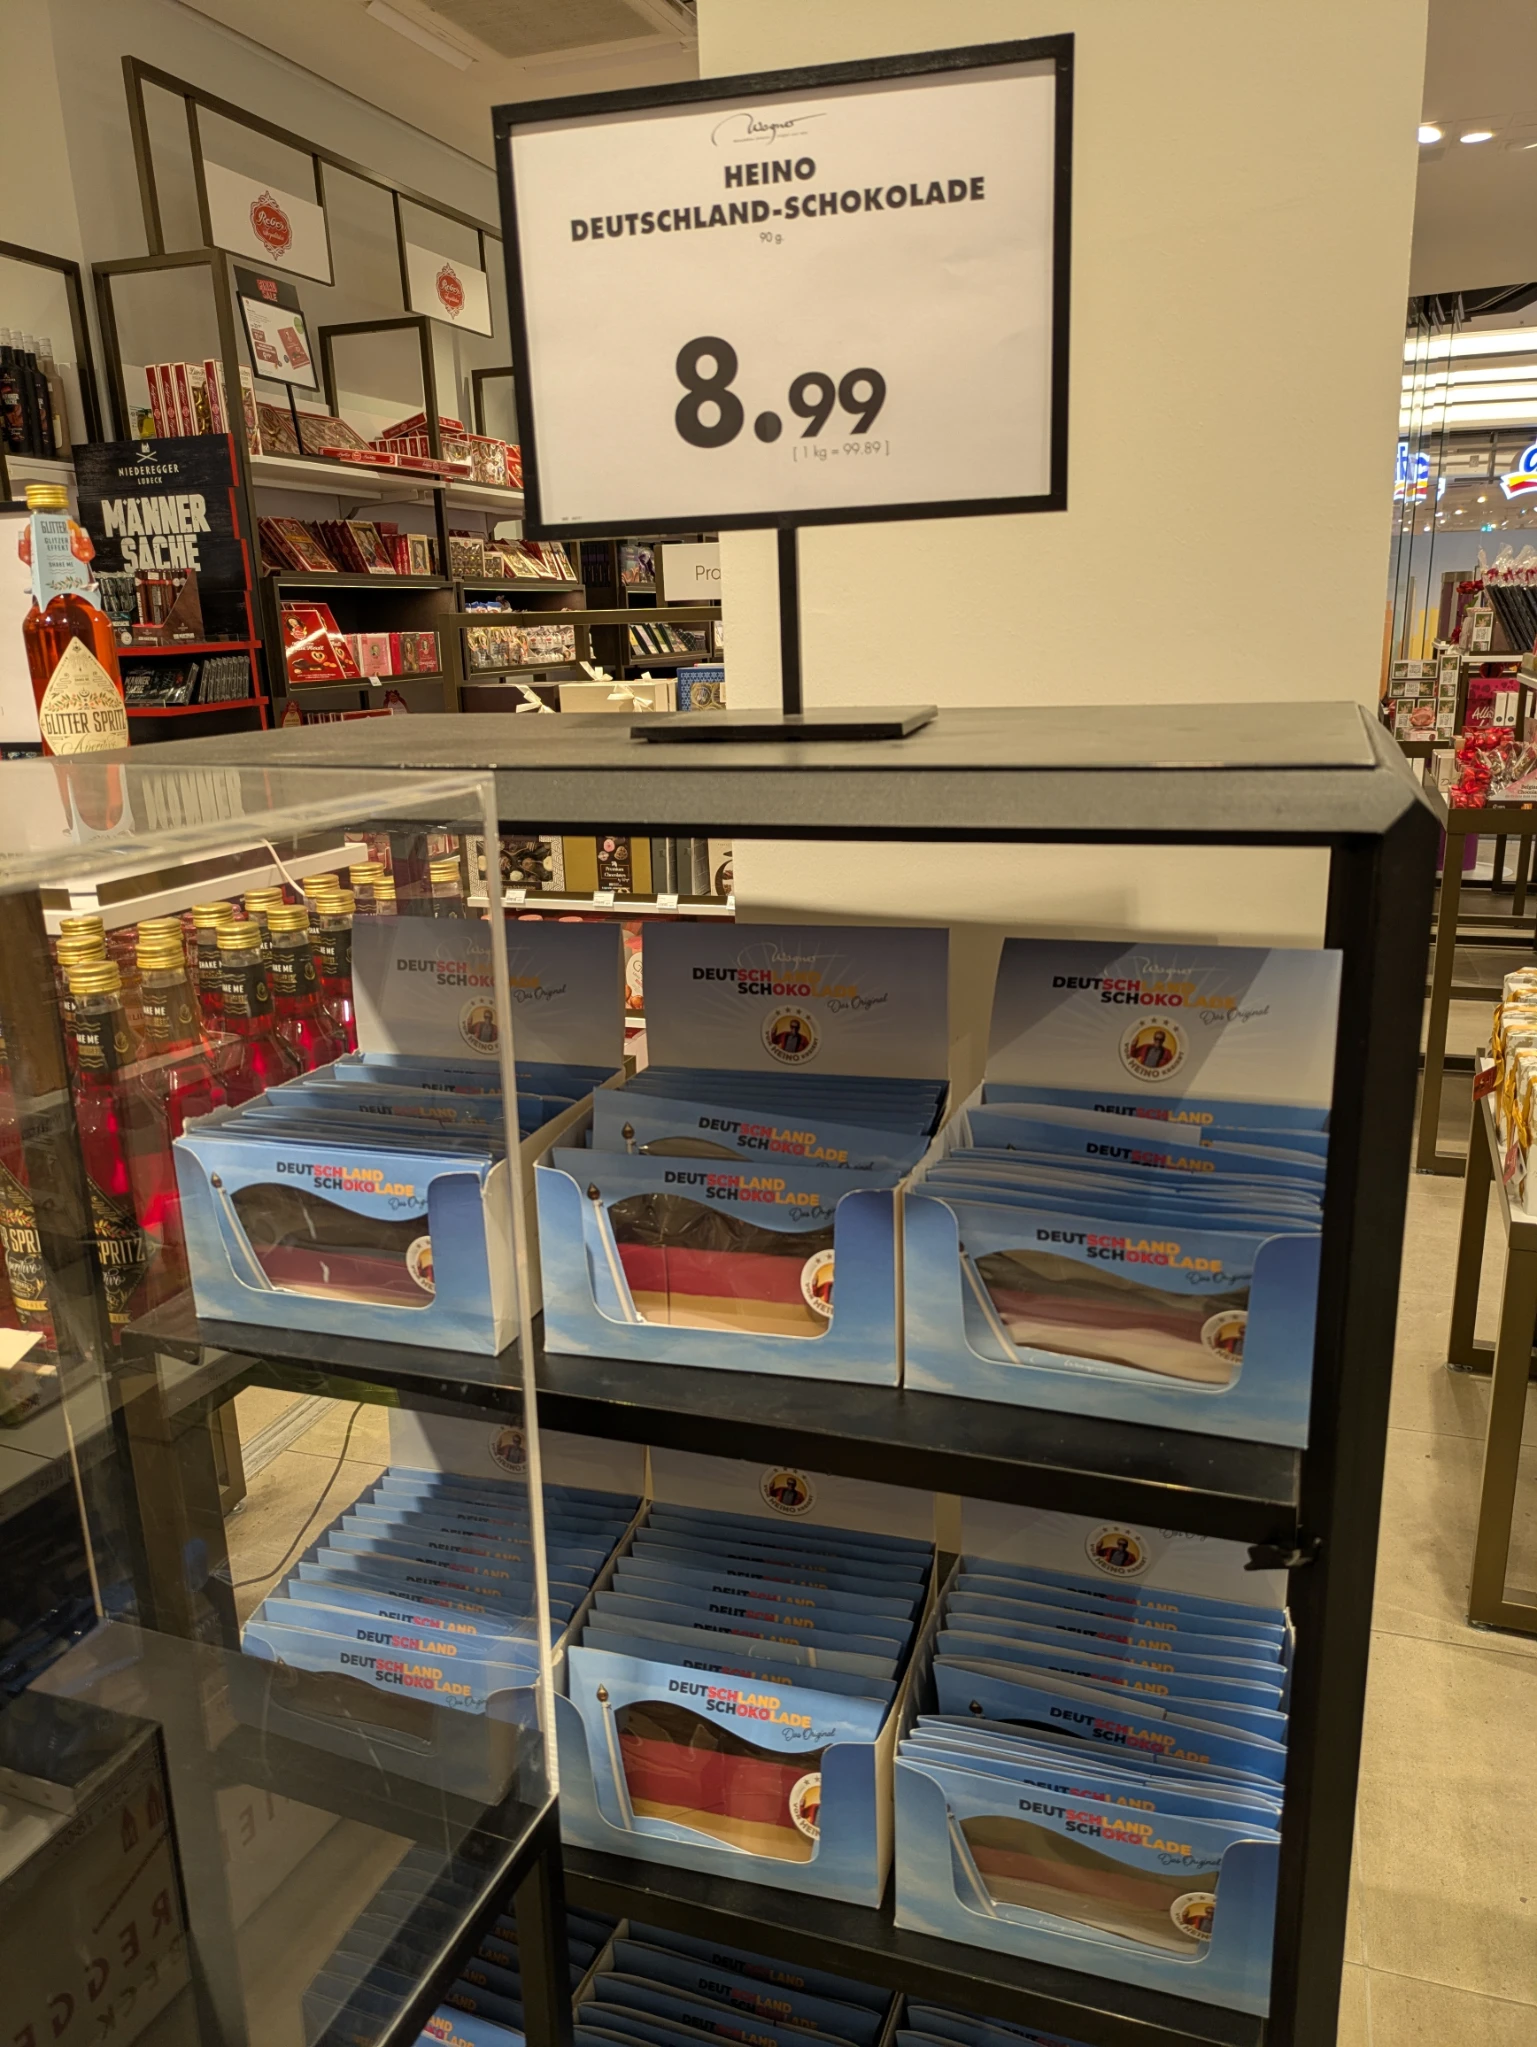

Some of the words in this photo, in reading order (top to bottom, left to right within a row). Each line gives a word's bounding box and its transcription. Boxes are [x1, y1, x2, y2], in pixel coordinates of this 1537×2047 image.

[724, 156, 817, 189] HEINO
[570, 176, 985, 242] DEUTSCHLAND-SCHOKOLADE
[759, 232, 773, 243] 90
[675, 335, 887, 449] 8.99
[813, 444, 827, 461] kg
[842, 441, 881, 456] 99.89
[118, 463, 180, 477] NIEDEREGGER
[101, 494, 212, 538] MÄNNER
[40, 521, 67, 534] GLITTER
[47, 544, 69, 552] EFFEKT
[120, 534, 202, 574] SACHE
[695, 564, 721, 581] Pro
[44, 712, 90, 735] GLITTER
[397, 959, 494, 975] DEUTSCHLA
[692, 967, 822, 984] DEUTSCHLAND
[534, 983, 567, 1001] Original
[737, 981, 858, 998] SCHOKOLADE
[1052, 976, 1196, 994] DEUTSCHLAND
[827, 999, 850, 1013] Das
[851, 992, 889, 1011] Original
[1101, 991, 1238, 1010] SCHOKOLADE
[1200, 1009, 1225, 1026] Das
[1227, 1004, 1270, 1024] Original
[468, 1036, 494, 1051] HEINO
[771, 1045, 800, 1061] HEINO
[1128, 1060, 1160, 1078] HEINO
[699, 1117, 816, 1145] DEUTSCHLAND
[737, 1135, 848, 1162] SCHOKOLADE
[1086, 1142, 1216, 1173] DEUTSCHLAND
[276, 1161, 384, 1183] DEUTSCHLAND
[664, 1171, 786, 1192] DEUTSCHLAND
[314, 1177, 415, 1197] SCHOKOLADE
[706, 1186, 820, 1207] SCHOKOLADE
[789, 1207, 810, 1222] Das
[9, 1228, 42, 1253] SPRI
[1036, 1229, 1181, 1256] DEUTSCHLAND
[1086, 1246, 1223, 1273] SCHOKOLADE
[813, 1299, 834, 1315] HEI
[1095, 1557, 1126, 1575] HEINO
[357, 1629, 458, 1657] DEUTSCHLAND
[340, 1652, 443, 1681] DEUTSCHLAND
[375, 1670, 472, 1697] SCHOKOLADE
[669, 1679, 781, 1710] DEUTSCHLAND
[706, 1699, 812, 1729] SCHOKOLADE
[782, 1727, 801, 1742] Das
[802, 1727, 837, 1743] Original
[1050, 1707, 1176, 1746] DEUTSCHLAND
[1092, 1728, 1210, 1764] SCHOKOLADE
[1018, 1799, 1154, 1838] DEUTSCHLAND
[1065, 1821, 1193, 1857] SCHOKOLADE
[1157, 1852, 1181, 1866] Das
[698, 1978, 793, 2014] DEUTSCHLAND
